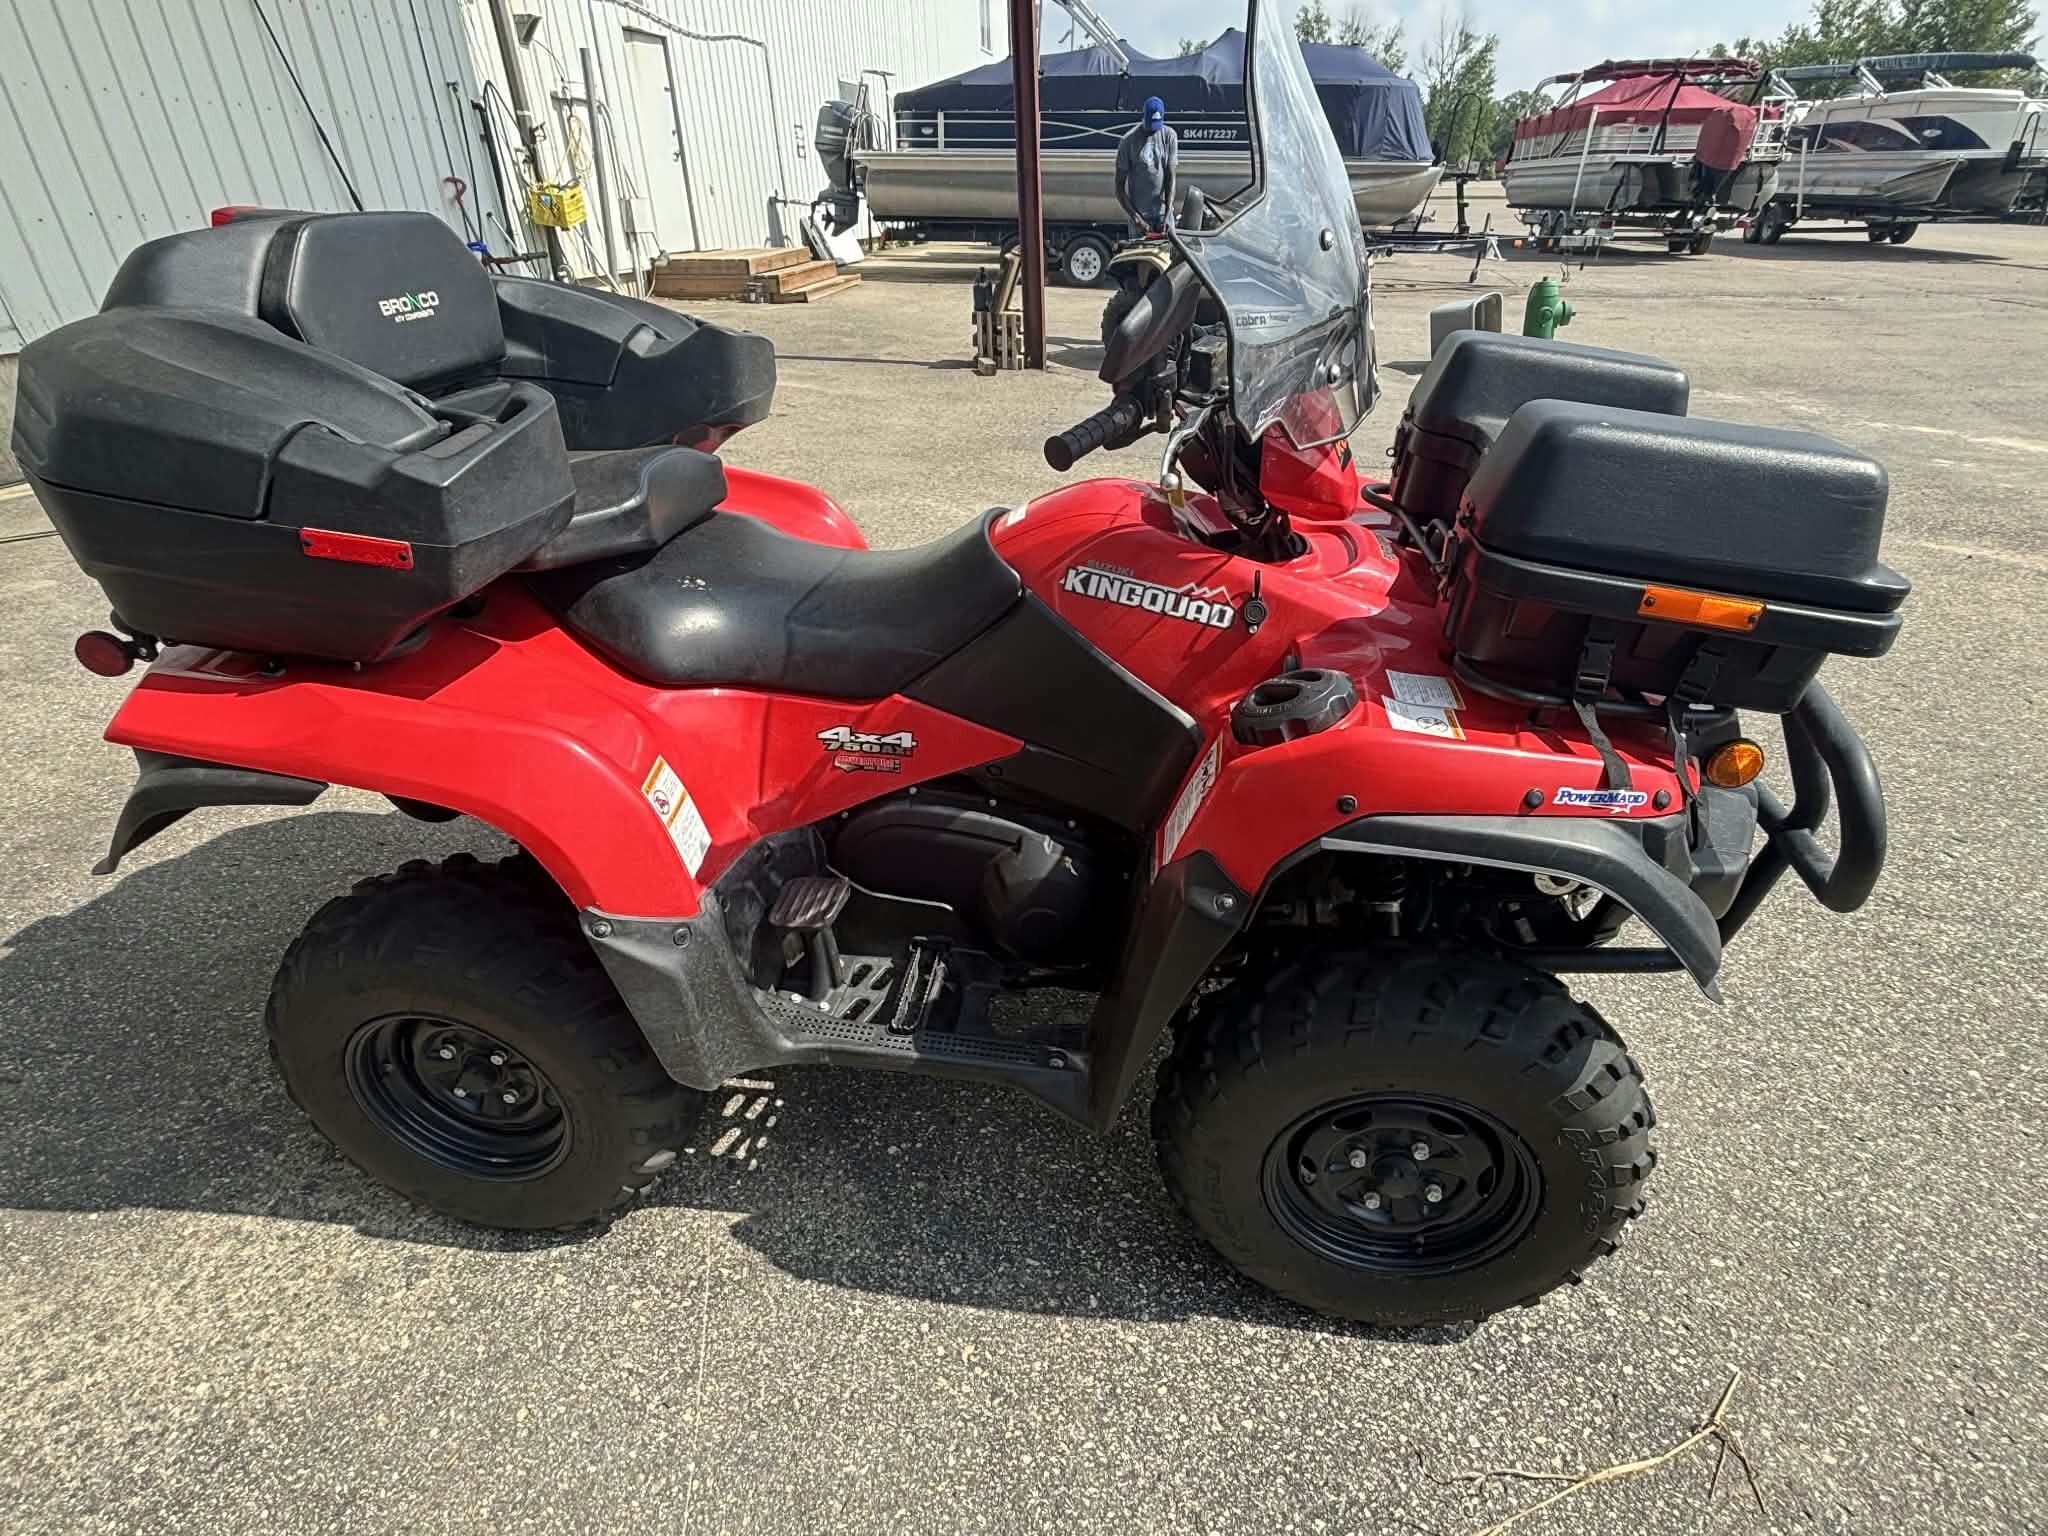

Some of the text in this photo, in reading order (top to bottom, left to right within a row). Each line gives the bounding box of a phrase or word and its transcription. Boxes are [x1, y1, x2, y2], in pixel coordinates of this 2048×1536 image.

[1183, 128, 1238, 139] SK4172237
[378, 291, 440, 316] BRONCO
[1086, 560, 1134, 576] SUZUKI
[1064, 568, 1235, 629] KINGQUAD
